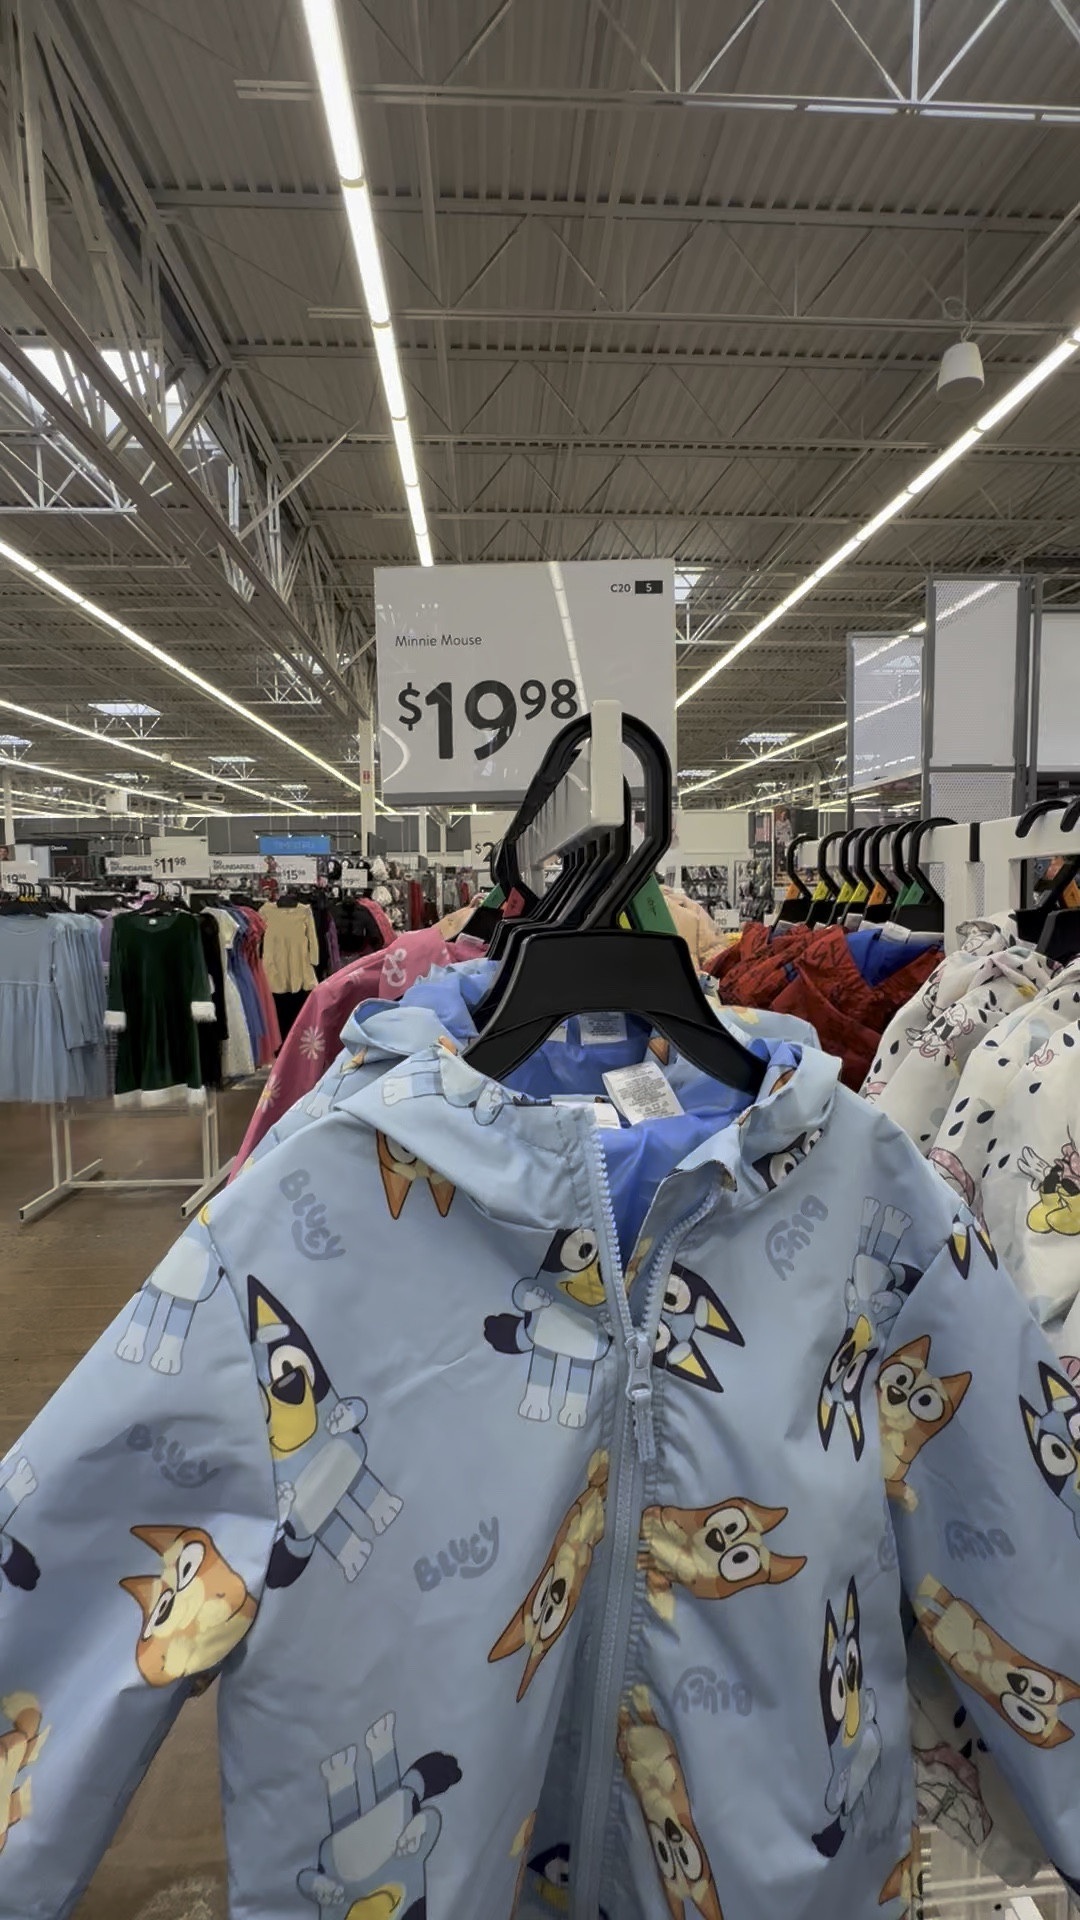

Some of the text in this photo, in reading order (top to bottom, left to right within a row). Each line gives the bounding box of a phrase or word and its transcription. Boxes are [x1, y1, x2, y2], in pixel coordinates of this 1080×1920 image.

[610, 583, 631, 593] C20
[395, 634, 482, 647] Minnie Mouse
